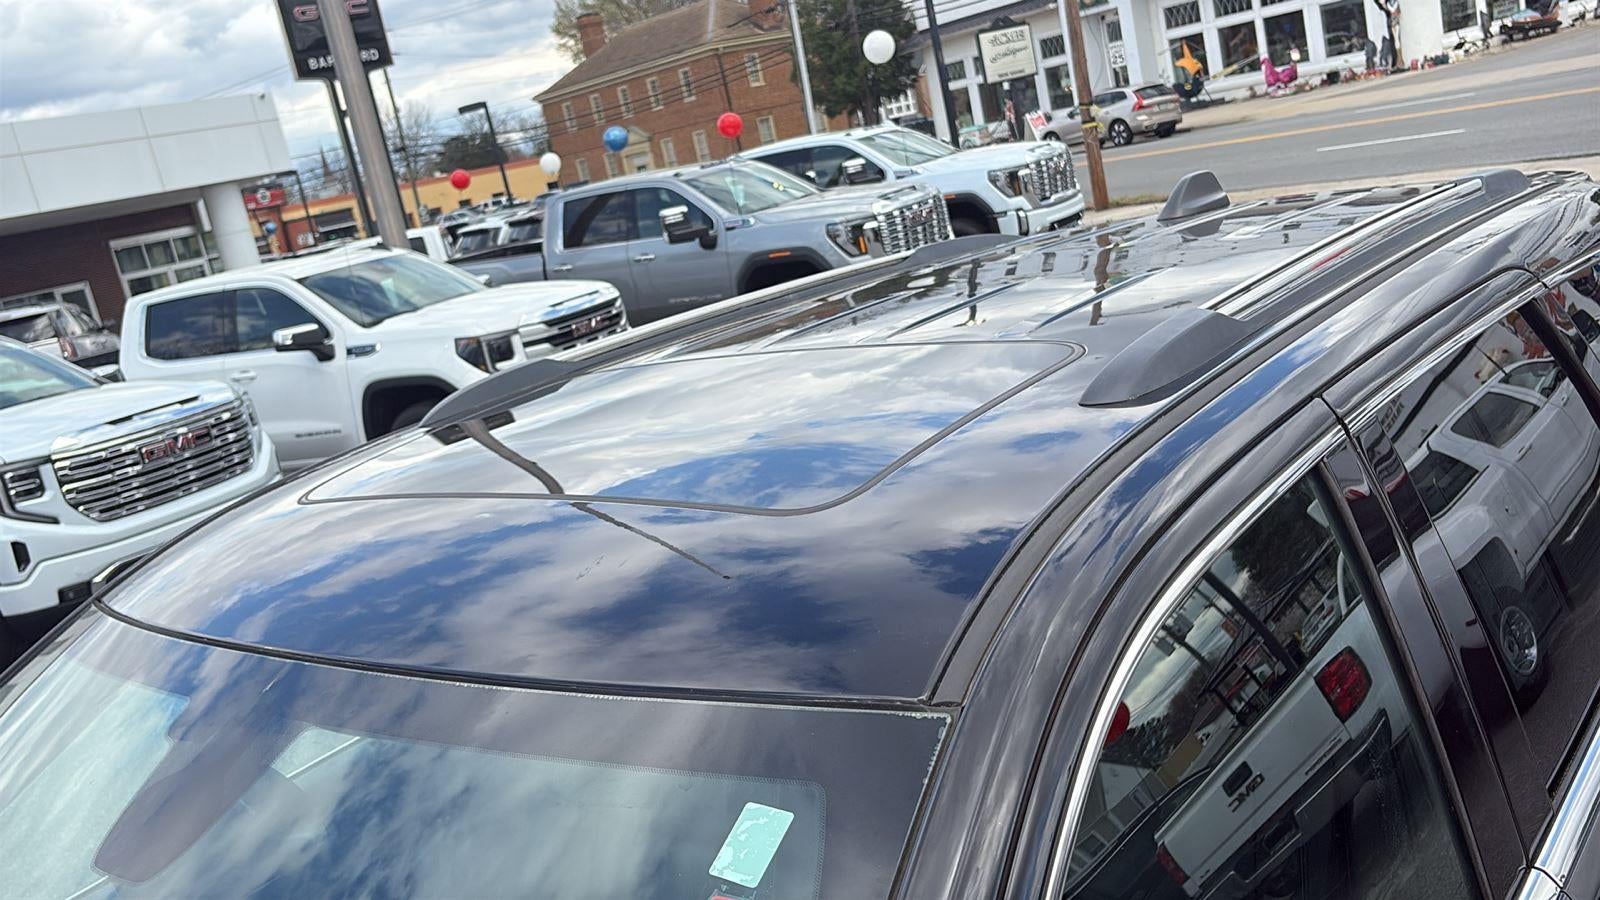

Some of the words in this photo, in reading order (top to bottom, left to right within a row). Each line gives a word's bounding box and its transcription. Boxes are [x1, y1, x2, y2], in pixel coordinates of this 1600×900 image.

[293, 0, 369, 22] GC
[1111, 55, 1124, 65] 25
[142, 427, 210, 464] GMC
